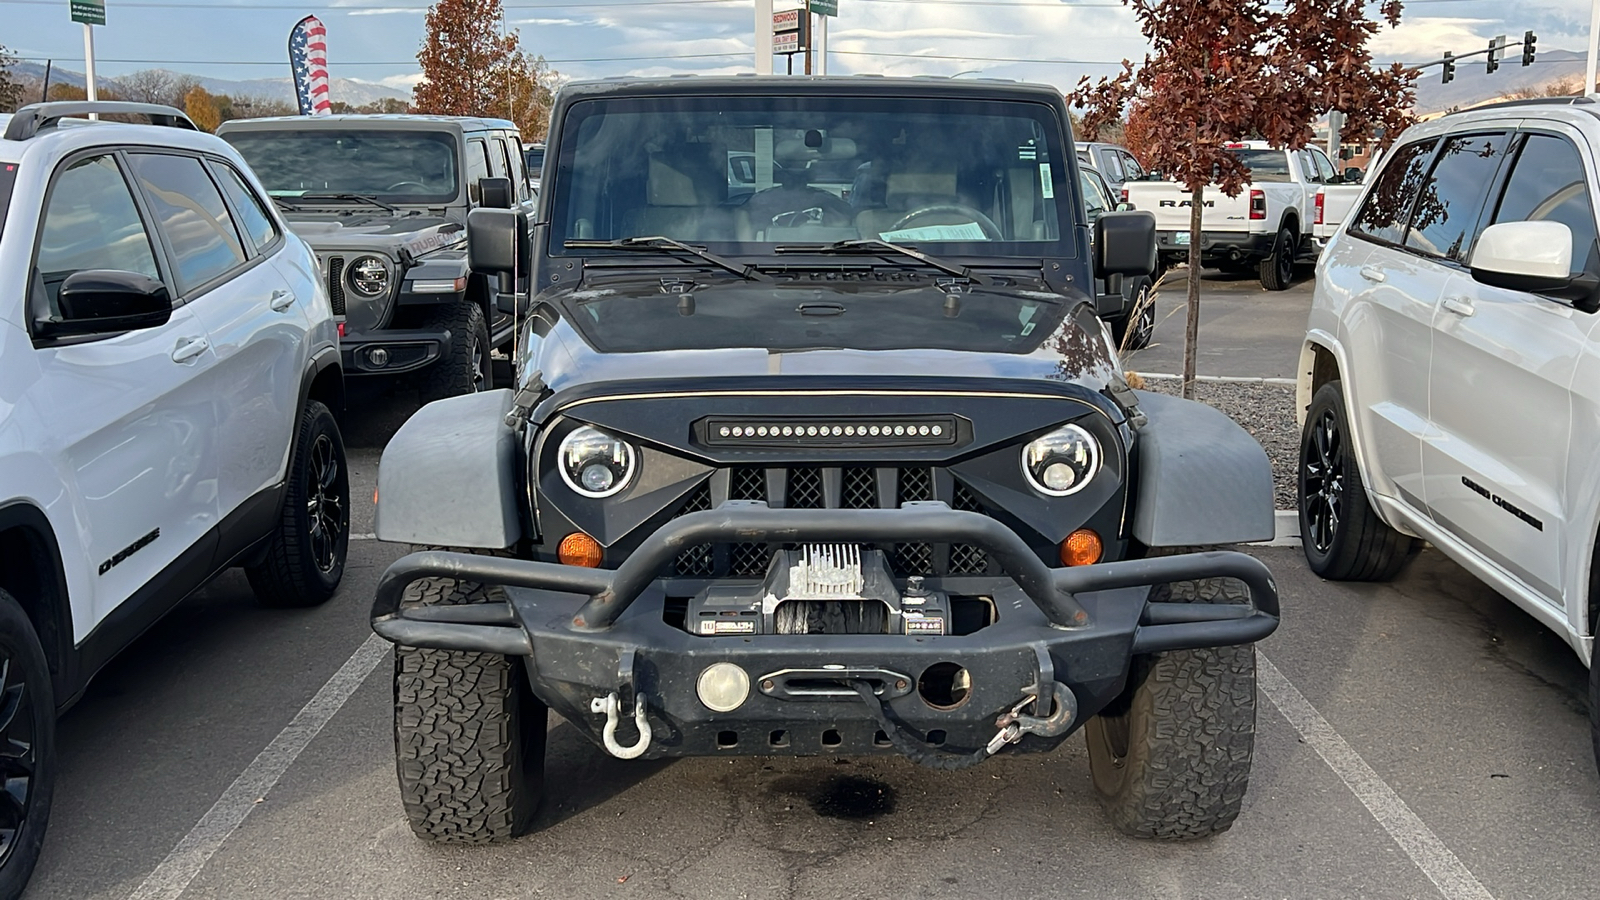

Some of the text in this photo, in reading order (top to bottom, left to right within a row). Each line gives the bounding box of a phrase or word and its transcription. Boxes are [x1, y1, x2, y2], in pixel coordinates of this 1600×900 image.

[773, 12, 798, 24] REDWOOD
[1160, 200, 1215, 208] RAM
[410, 231, 457, 255] RUBICON
[1492, 494, 1543, 532] CHEROKEE
[99, 526, 160, 576] CHEROKEE
[715, 621, 754, 630] STEALTH
